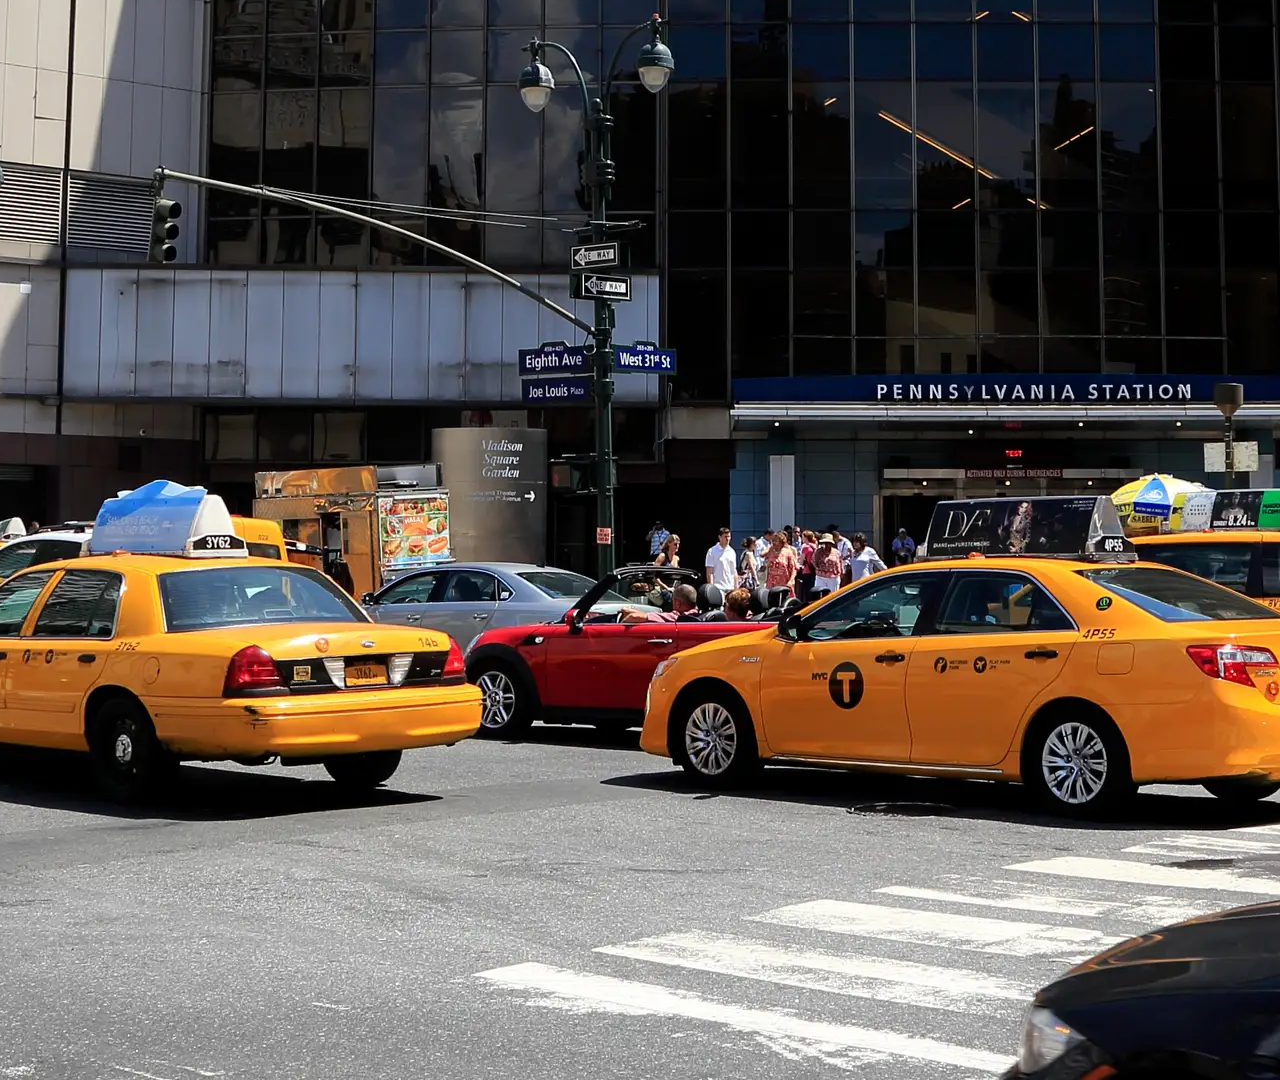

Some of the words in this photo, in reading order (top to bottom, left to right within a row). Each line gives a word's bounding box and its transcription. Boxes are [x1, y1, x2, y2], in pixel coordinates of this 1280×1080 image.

[578, 252, 592, 262] ONE
[597, 250, 611, 260] WAY
[589, 280, 604, 290] ONE
[608, 283, 622, 291] WAY
[525, 353, 559, 370] Eighth
[562, 353, 583, 366] Ave
[620, 352, 643, 366] West
[644, 354, 660, 367] 31st
[661, 355, 671, 369] St
[528, 385, 543, 399] Joe
[545, 384, 568, 398] Louis
[570, 387, 584, 396] Plaza
[877, 383, 1076, 402] PENNSYLVANIA
[1087, 383, 1193, 401] STATION
[483, 453, 520, 467] Square
[482, 466, 520, 478] Garden
[404, 516, 425, 524] HALAL
[1228, 514, 1248, 526] 8.24
[205, 536, 231, 549] 3Y62
[1104, 539, 1124, 552] 4P55
[1082, 628, 1117, 641] 4P55
[811, 672, 828, 681] NYC
[836, 671, 856, 703] T
